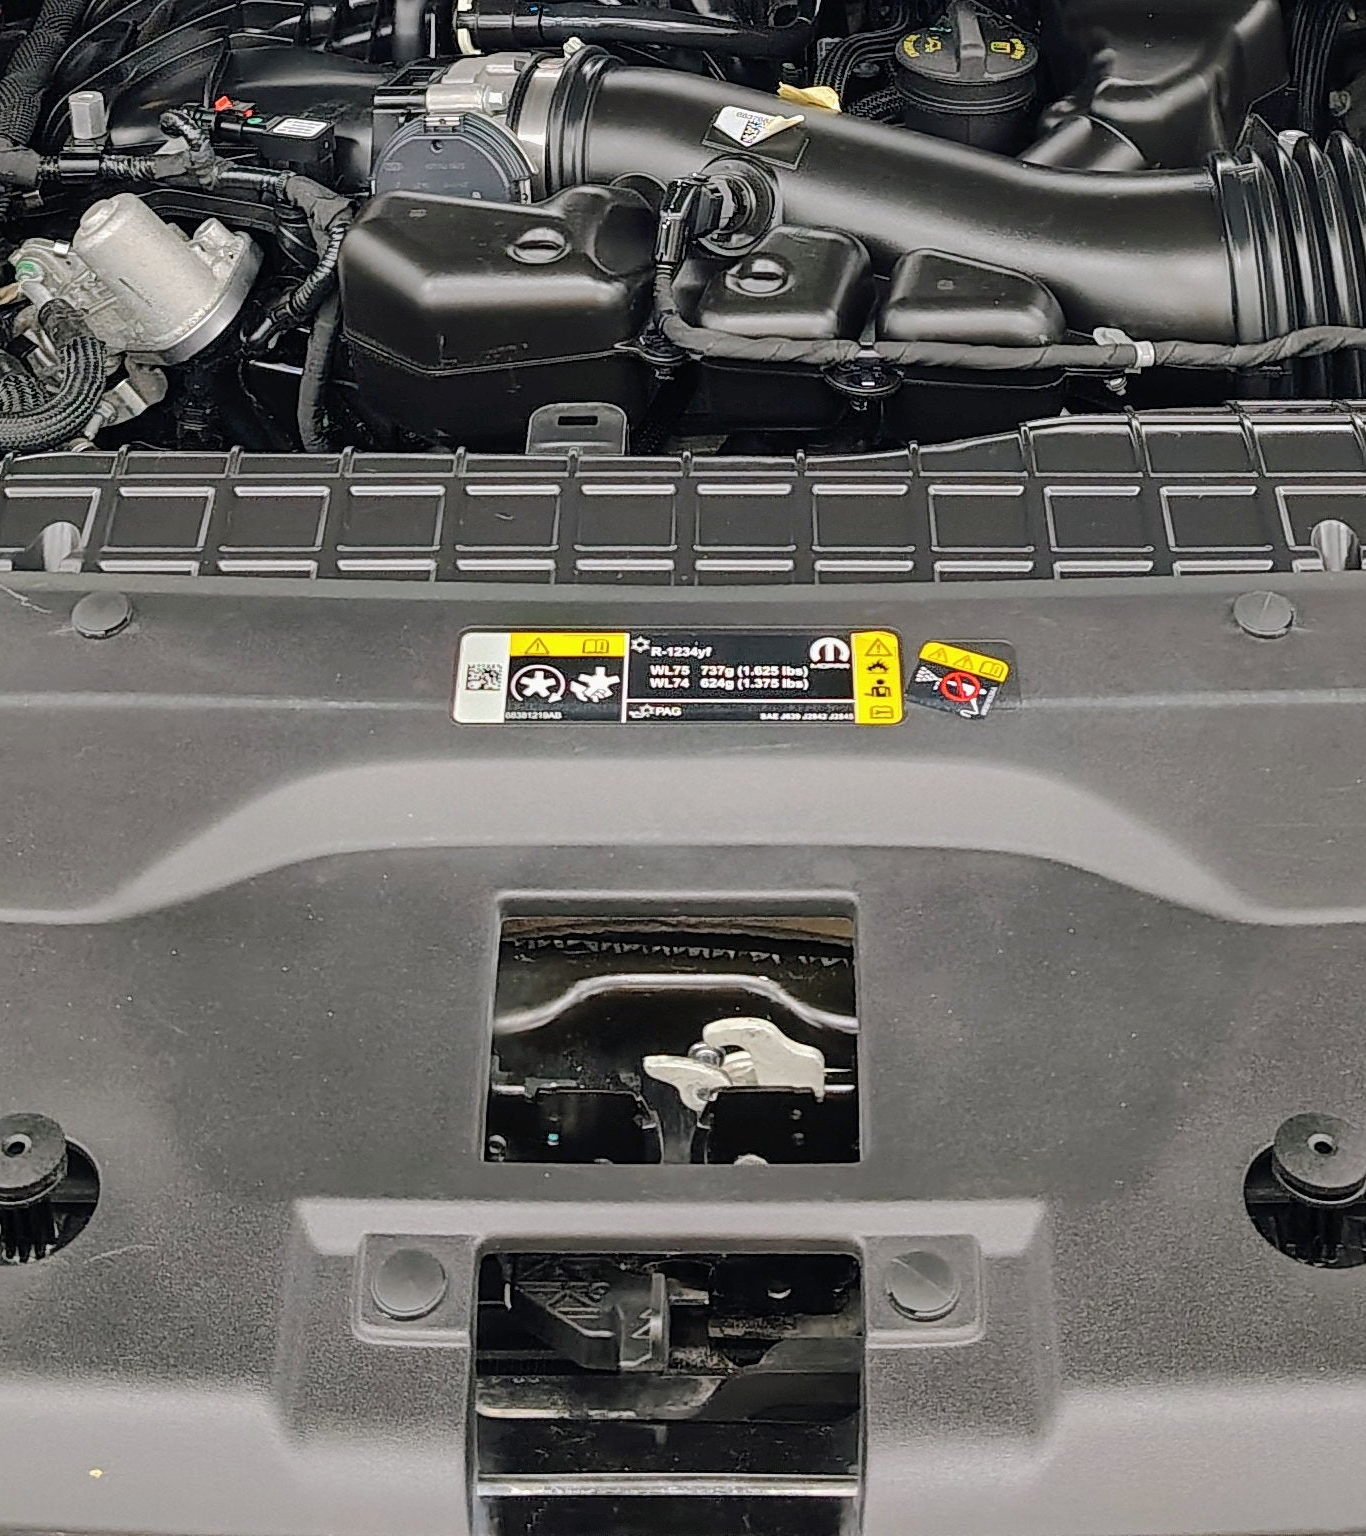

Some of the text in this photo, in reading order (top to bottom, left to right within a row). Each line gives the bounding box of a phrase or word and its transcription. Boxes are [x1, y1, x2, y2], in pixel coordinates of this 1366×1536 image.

[650, 646, 713, 659] R-1234yf
[649, 664, 809, 678] WL75 737g (1.625 lbs)
[649, 677, 810, 691] WL74 624g (1.375 lbs)
[654, 707, 682, 717] PAG
